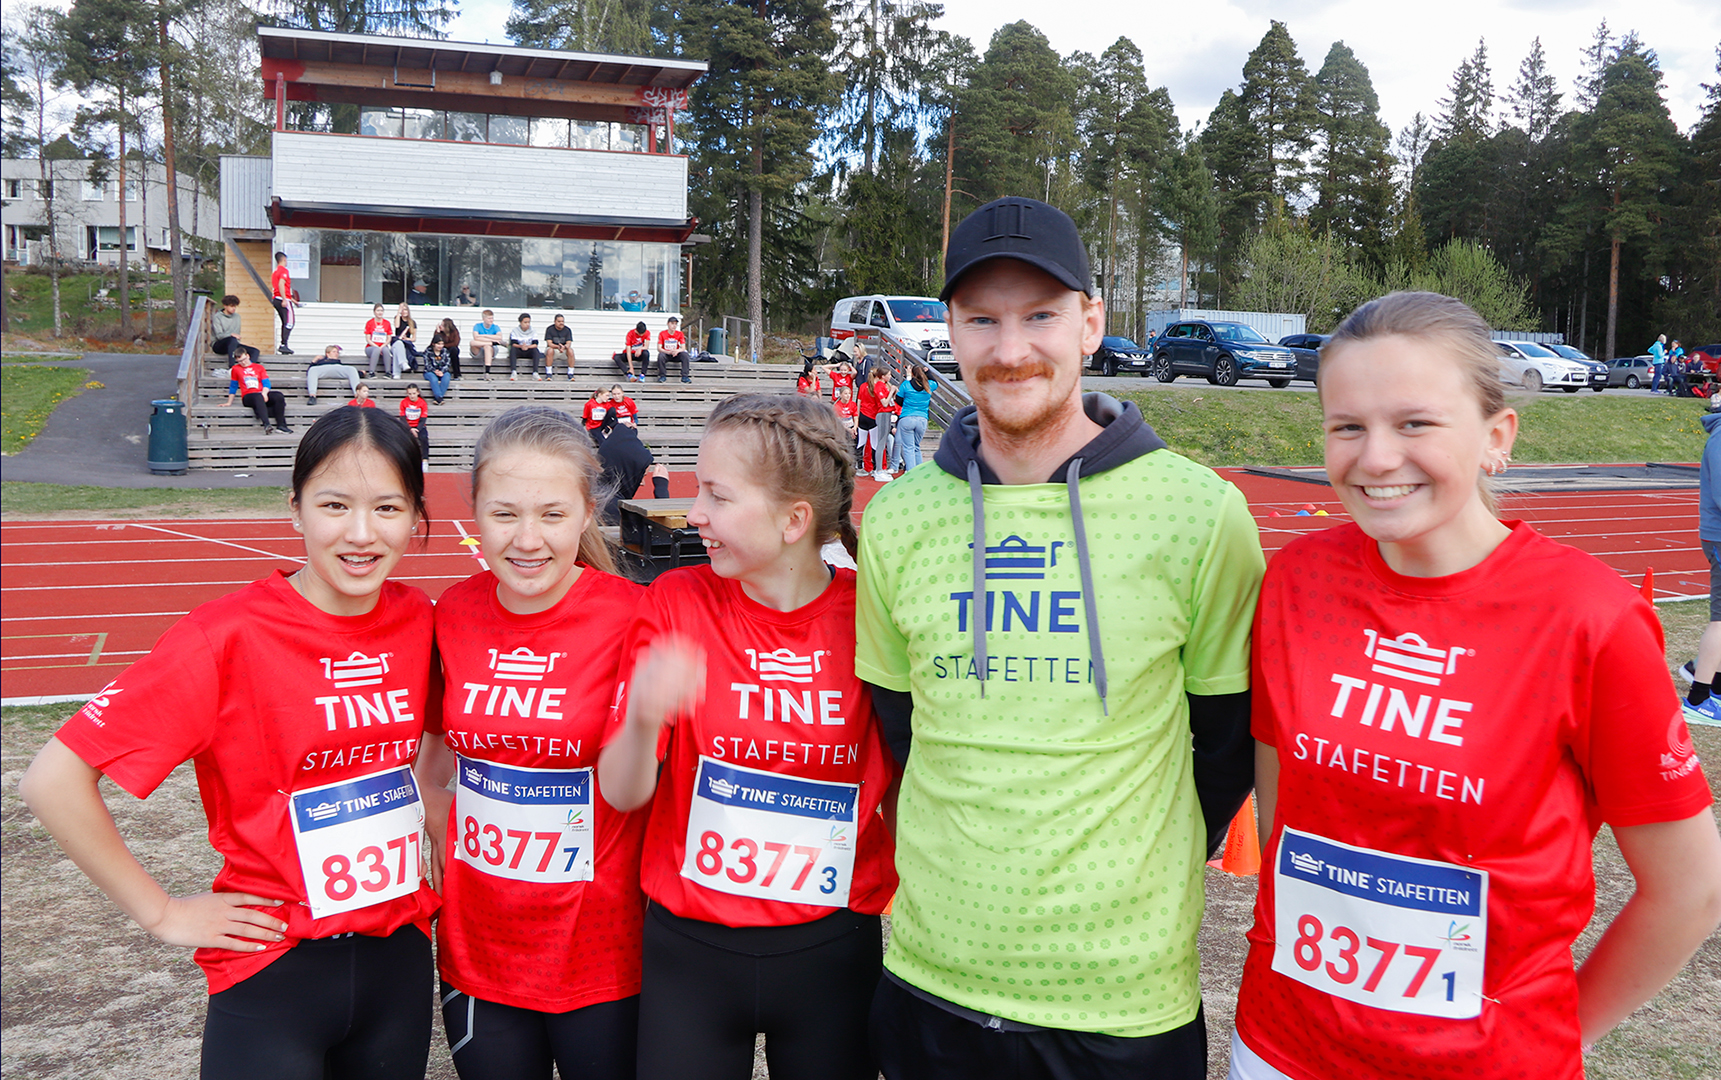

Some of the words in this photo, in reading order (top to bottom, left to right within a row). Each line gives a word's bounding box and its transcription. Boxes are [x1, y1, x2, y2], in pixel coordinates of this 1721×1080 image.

[950, 589, 1081, 634] TINE
[315, 689, 414, 730] TINE
[463, 682, 566, 720] TINE
[731, 683, 845, 725] TINE
[1331, 673, 1473, 747] TINE
[449, 730, 581, 758] STAFETTEN
[710, 736, 857, 766] STAFETTEN
[483, 777, 511, 794] TINE
[515, 786, 580, 797] STAFETTEN
[1294, 732, 1484, 804] STAFETTEN
[343, 793, 380, 813] TINE
[741, 787, 779, 804] TINE
[780, 794, 846, 816] STAFETTEN
[460, 816, 562, 874] 8377
[564, 847, 579, 871] 7
[694, 831, 822, 892] 8377
[820, 867, 837, 894] 3
[1326, 865, 1370, 890] TINE
[1375, 878, 1469, 907] STAFETTEN
[1291, 914, 1442, 999] 8377
[1443, 972, 1455, 1001] 1
